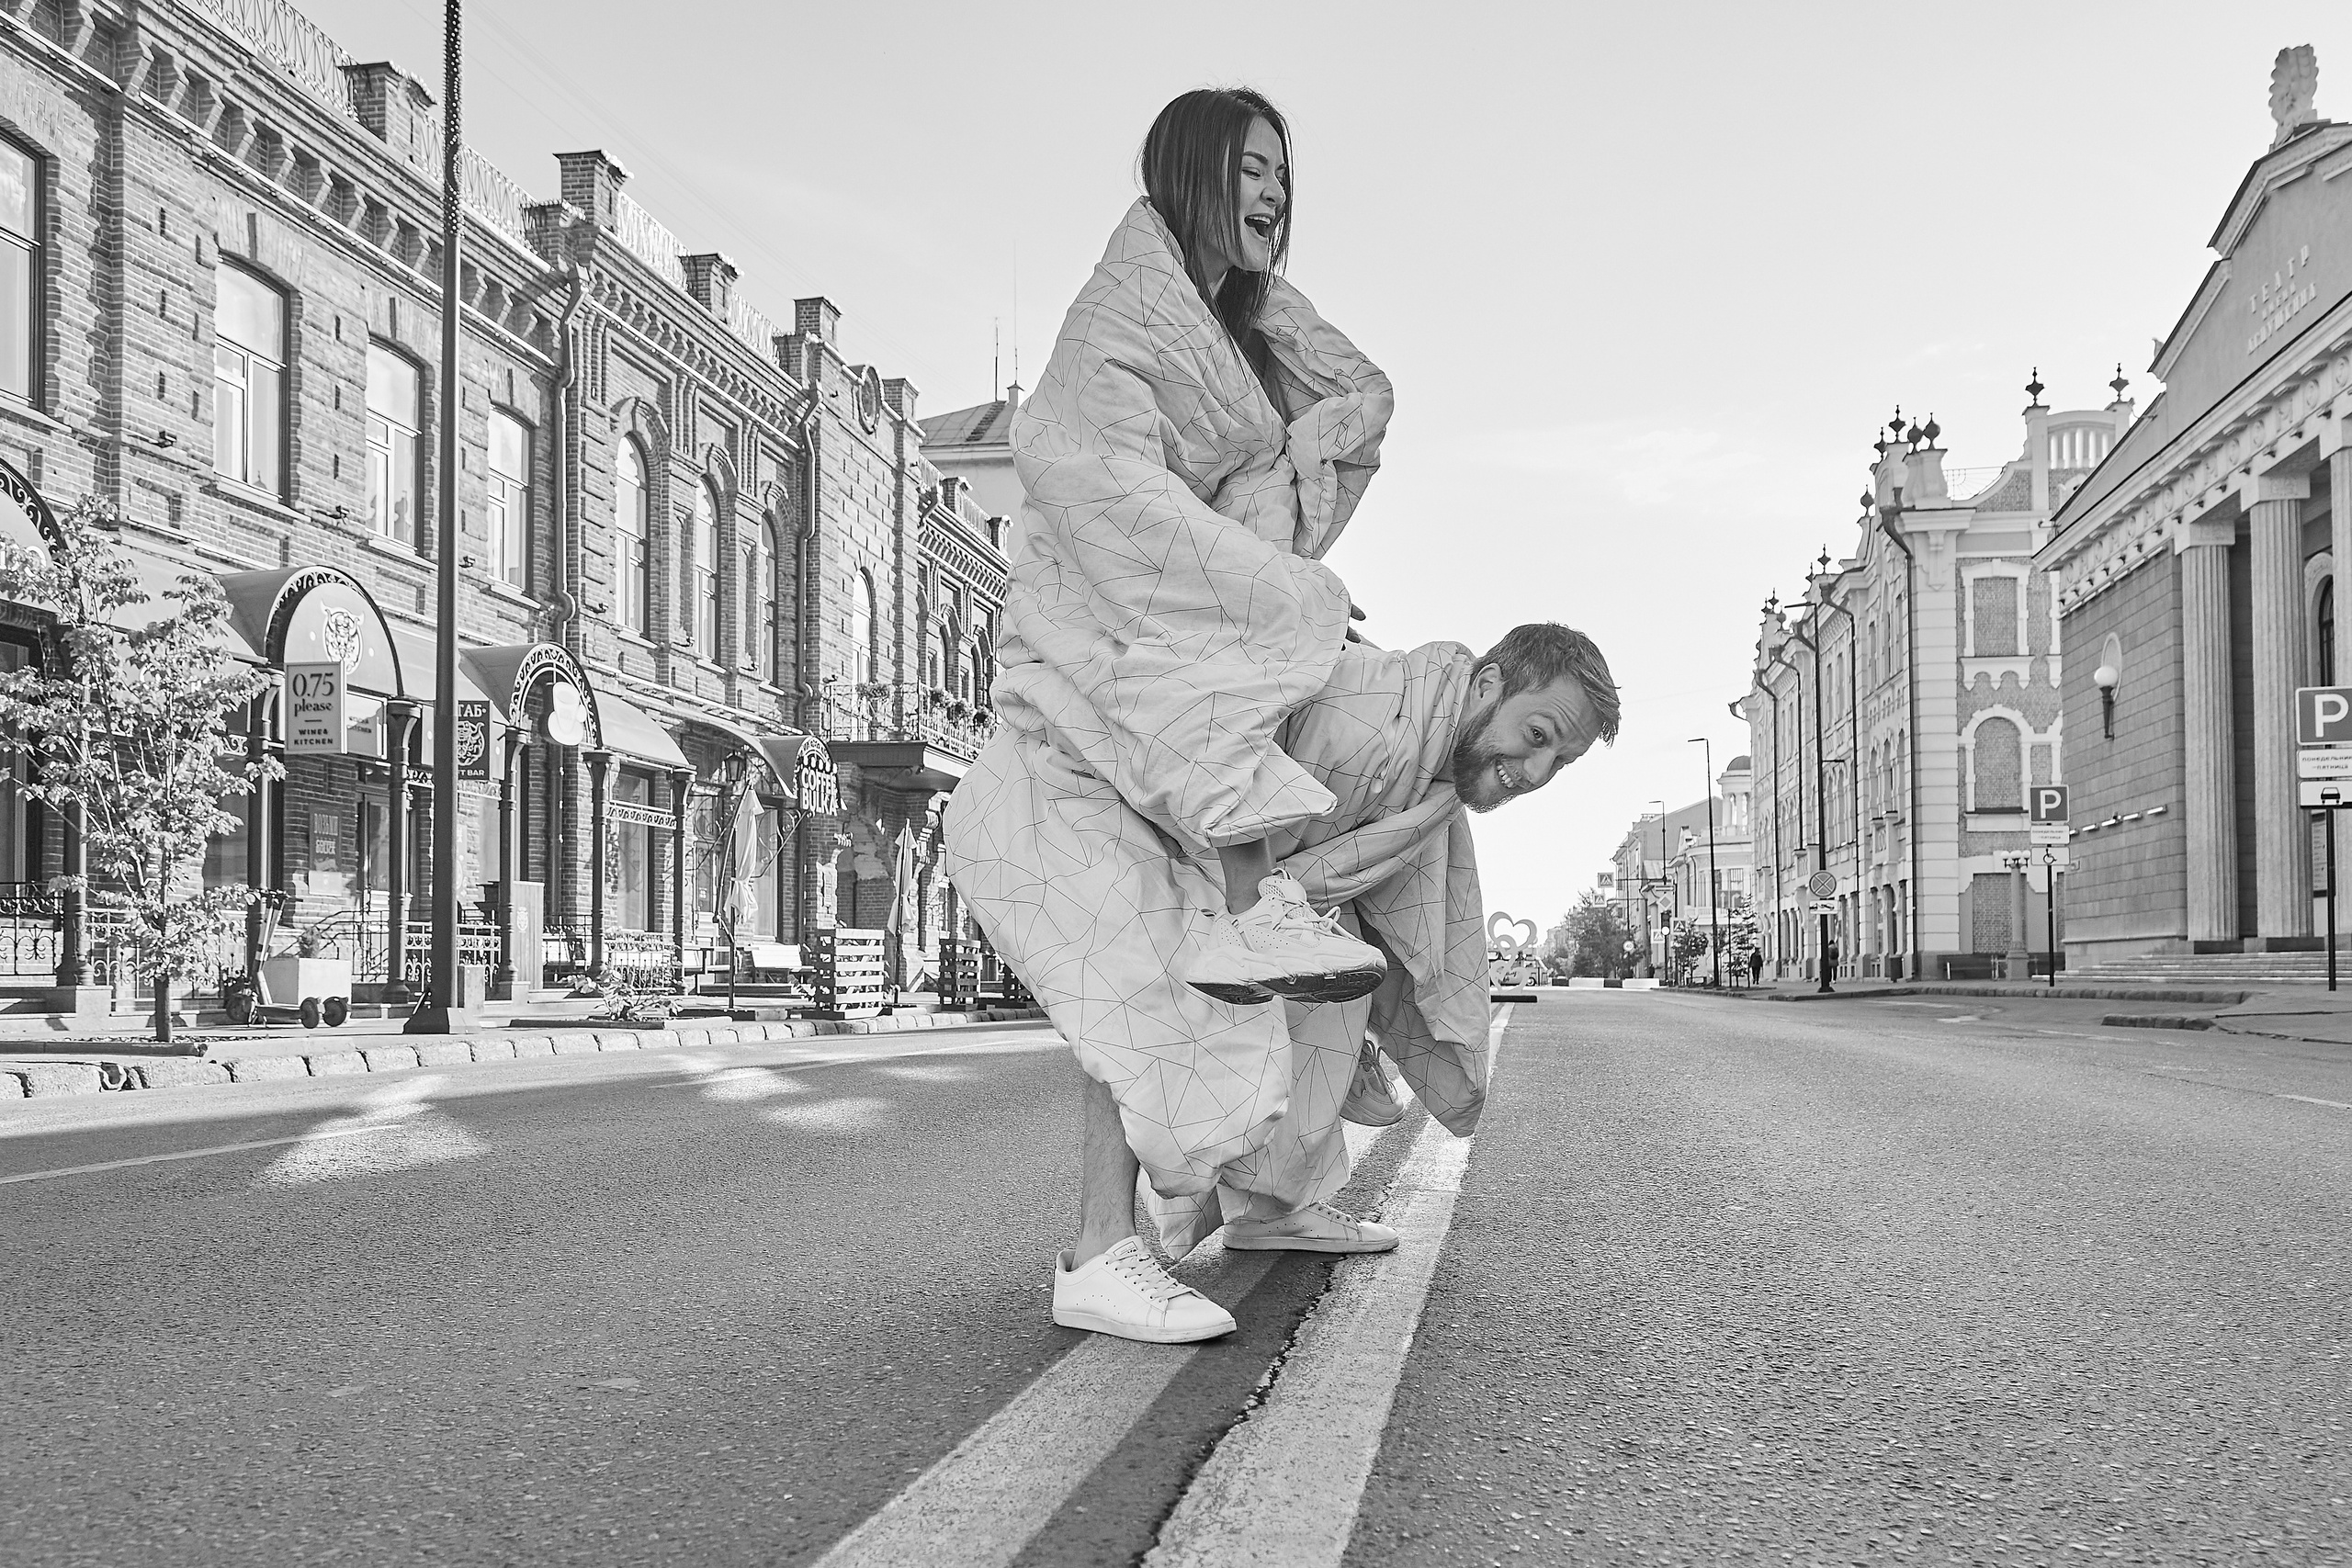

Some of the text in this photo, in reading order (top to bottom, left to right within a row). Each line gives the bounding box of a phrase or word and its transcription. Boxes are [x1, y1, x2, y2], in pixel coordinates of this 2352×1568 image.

[2250, 245, 2309, 314] ТЕАТР
[292, 672, 334, 698] 0.75
[294, 698, 333, 717] please
[458, 704, 482, 717] ТАБ
[2314, 694, 2349, 738] P
[801, 767, 837, 796] COFFEE
[801, 788, 838, 817] BULKA
[2040, 789, 2062, 819] P
